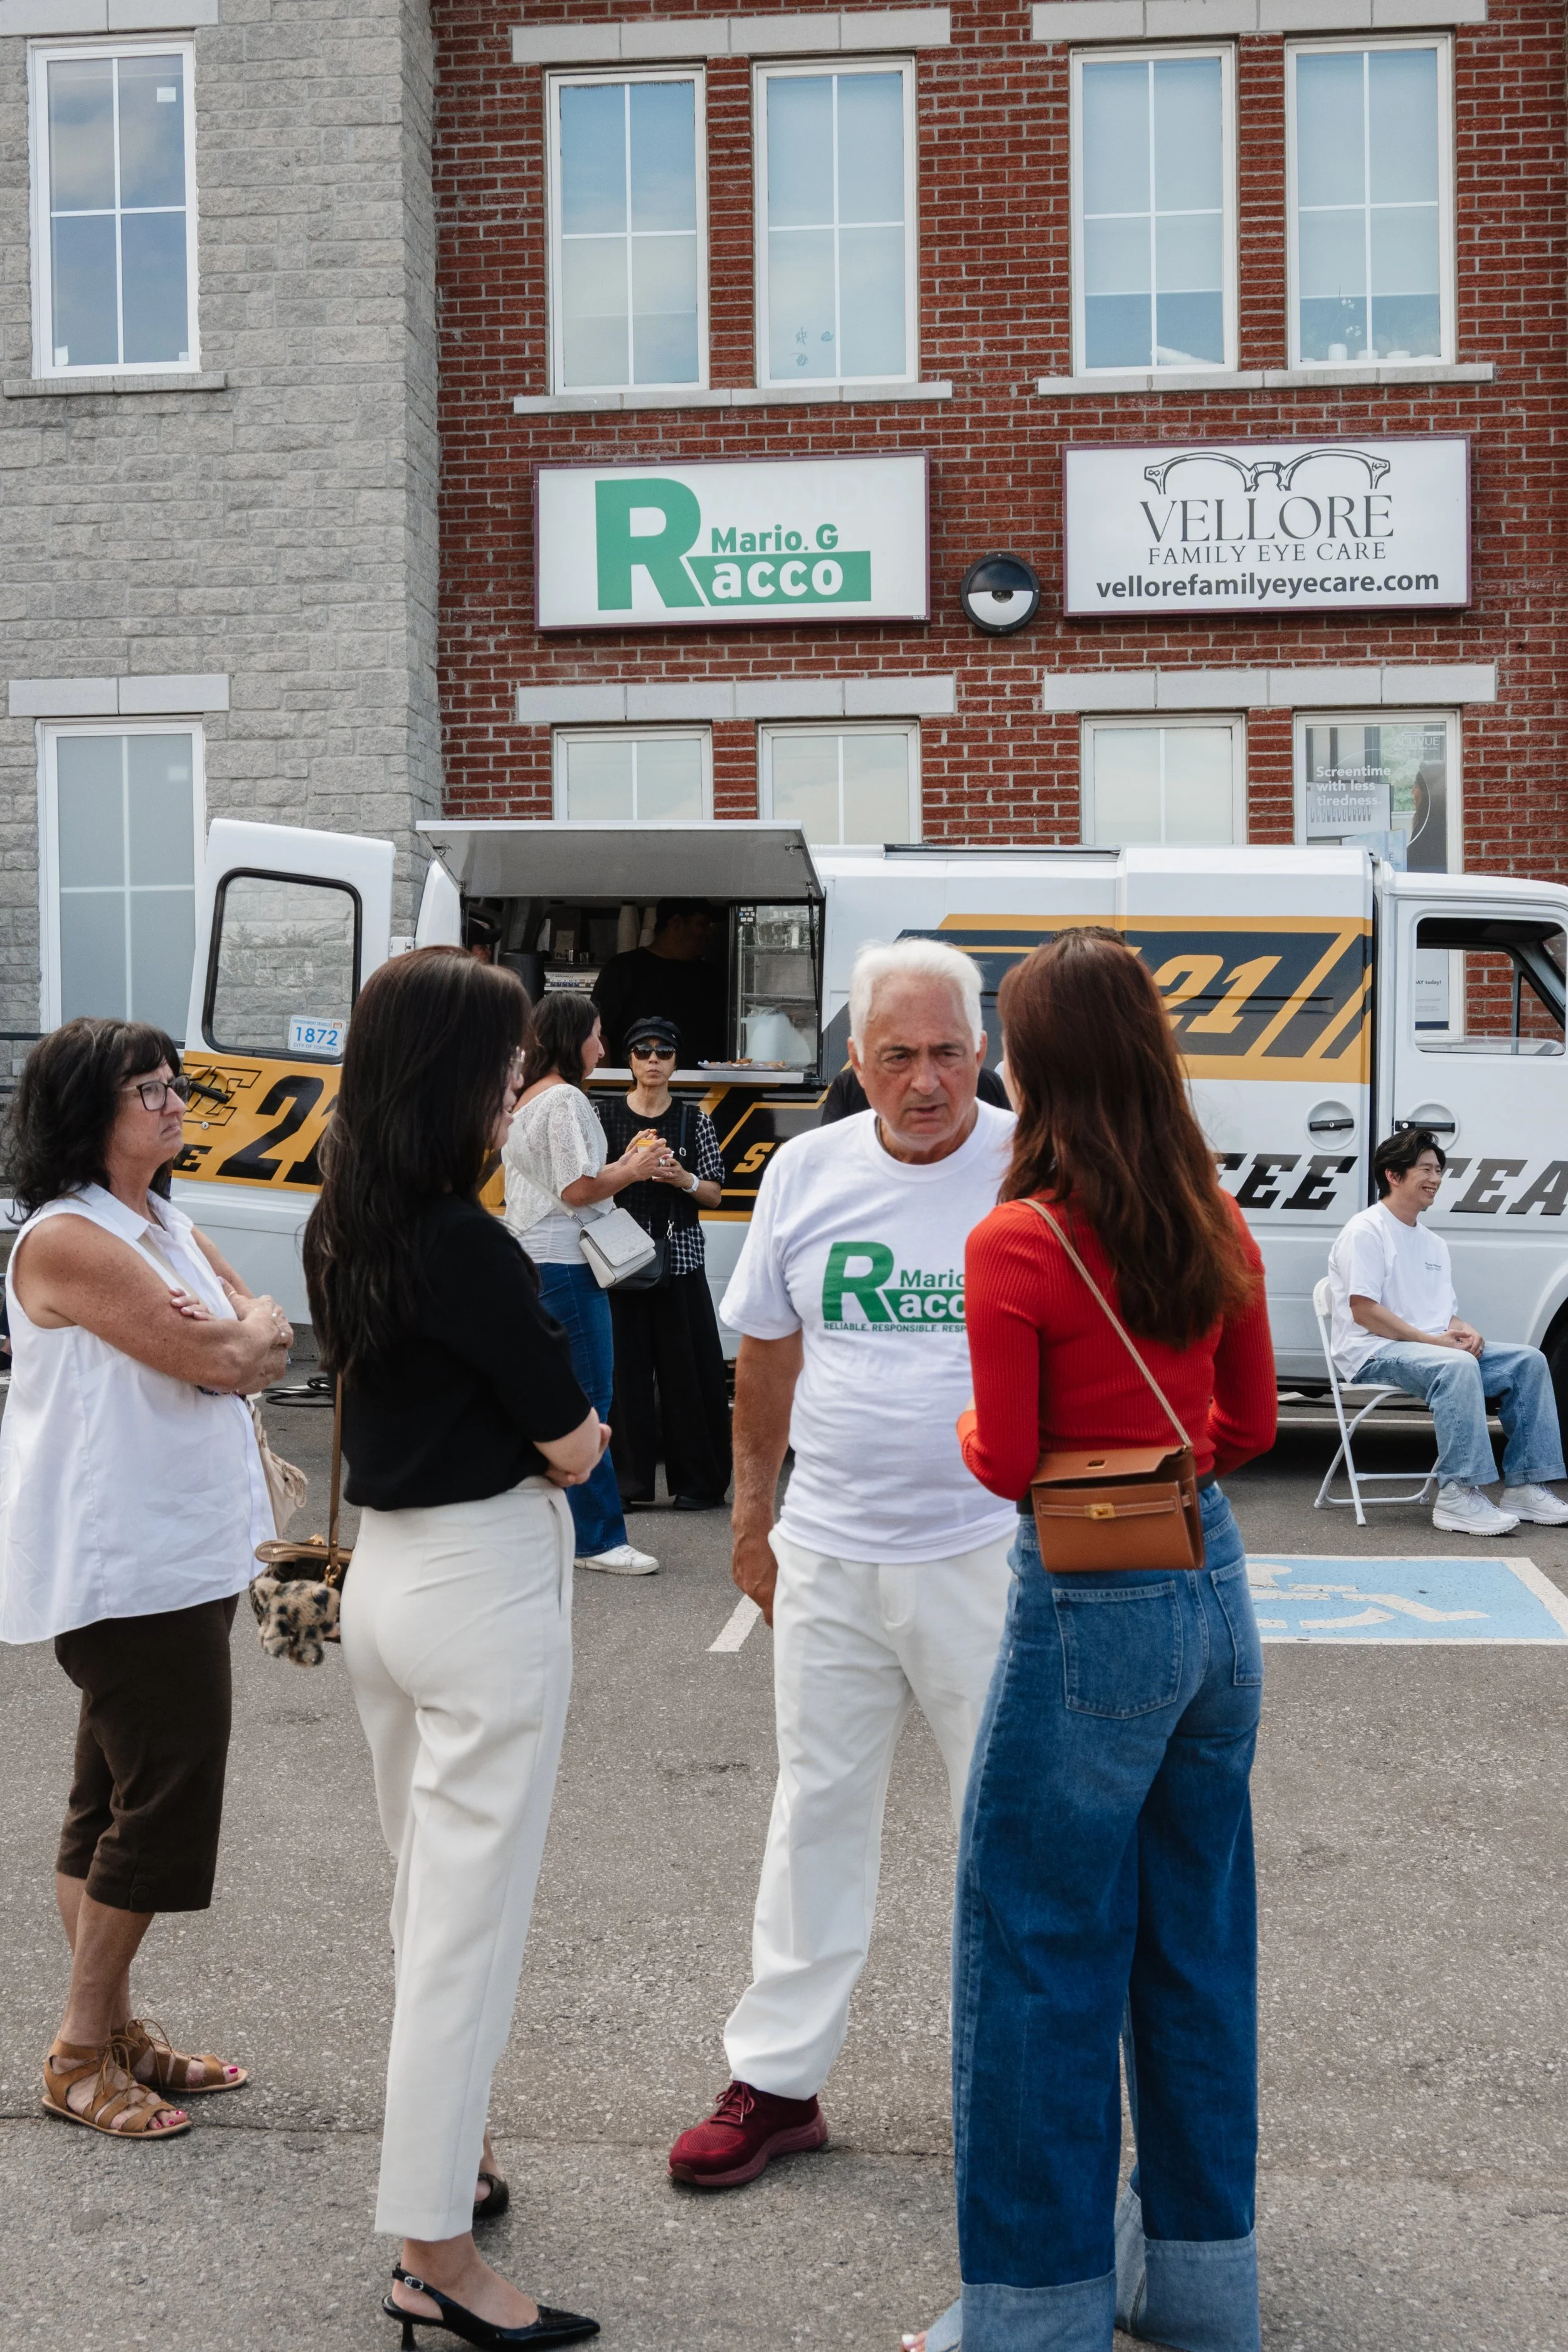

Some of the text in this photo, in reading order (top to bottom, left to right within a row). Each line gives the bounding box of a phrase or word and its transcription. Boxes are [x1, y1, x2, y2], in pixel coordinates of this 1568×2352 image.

[1140, 495, 1394, 543] VELLORE
[816, 524, 839, 550] G
[1148, 542, 1386, 564] FAMILY EYE CARE
[1096, 572, 1439, 600] vellorefamilyeyecare.com
[1394, 736, 1440, 746] ACUVUE
[1316, 765, 1391, 778] Screentime
[1316, 779, 1375, 792] with less
[1316, 793, 1382, 806] tiredness.
[1152, 954, 1283, 1034] 21
[296, 1027, 337, 1046] 1872
[824, 1322, 967, 1333] RELIABLE. RESPONSIBLE. RESP
